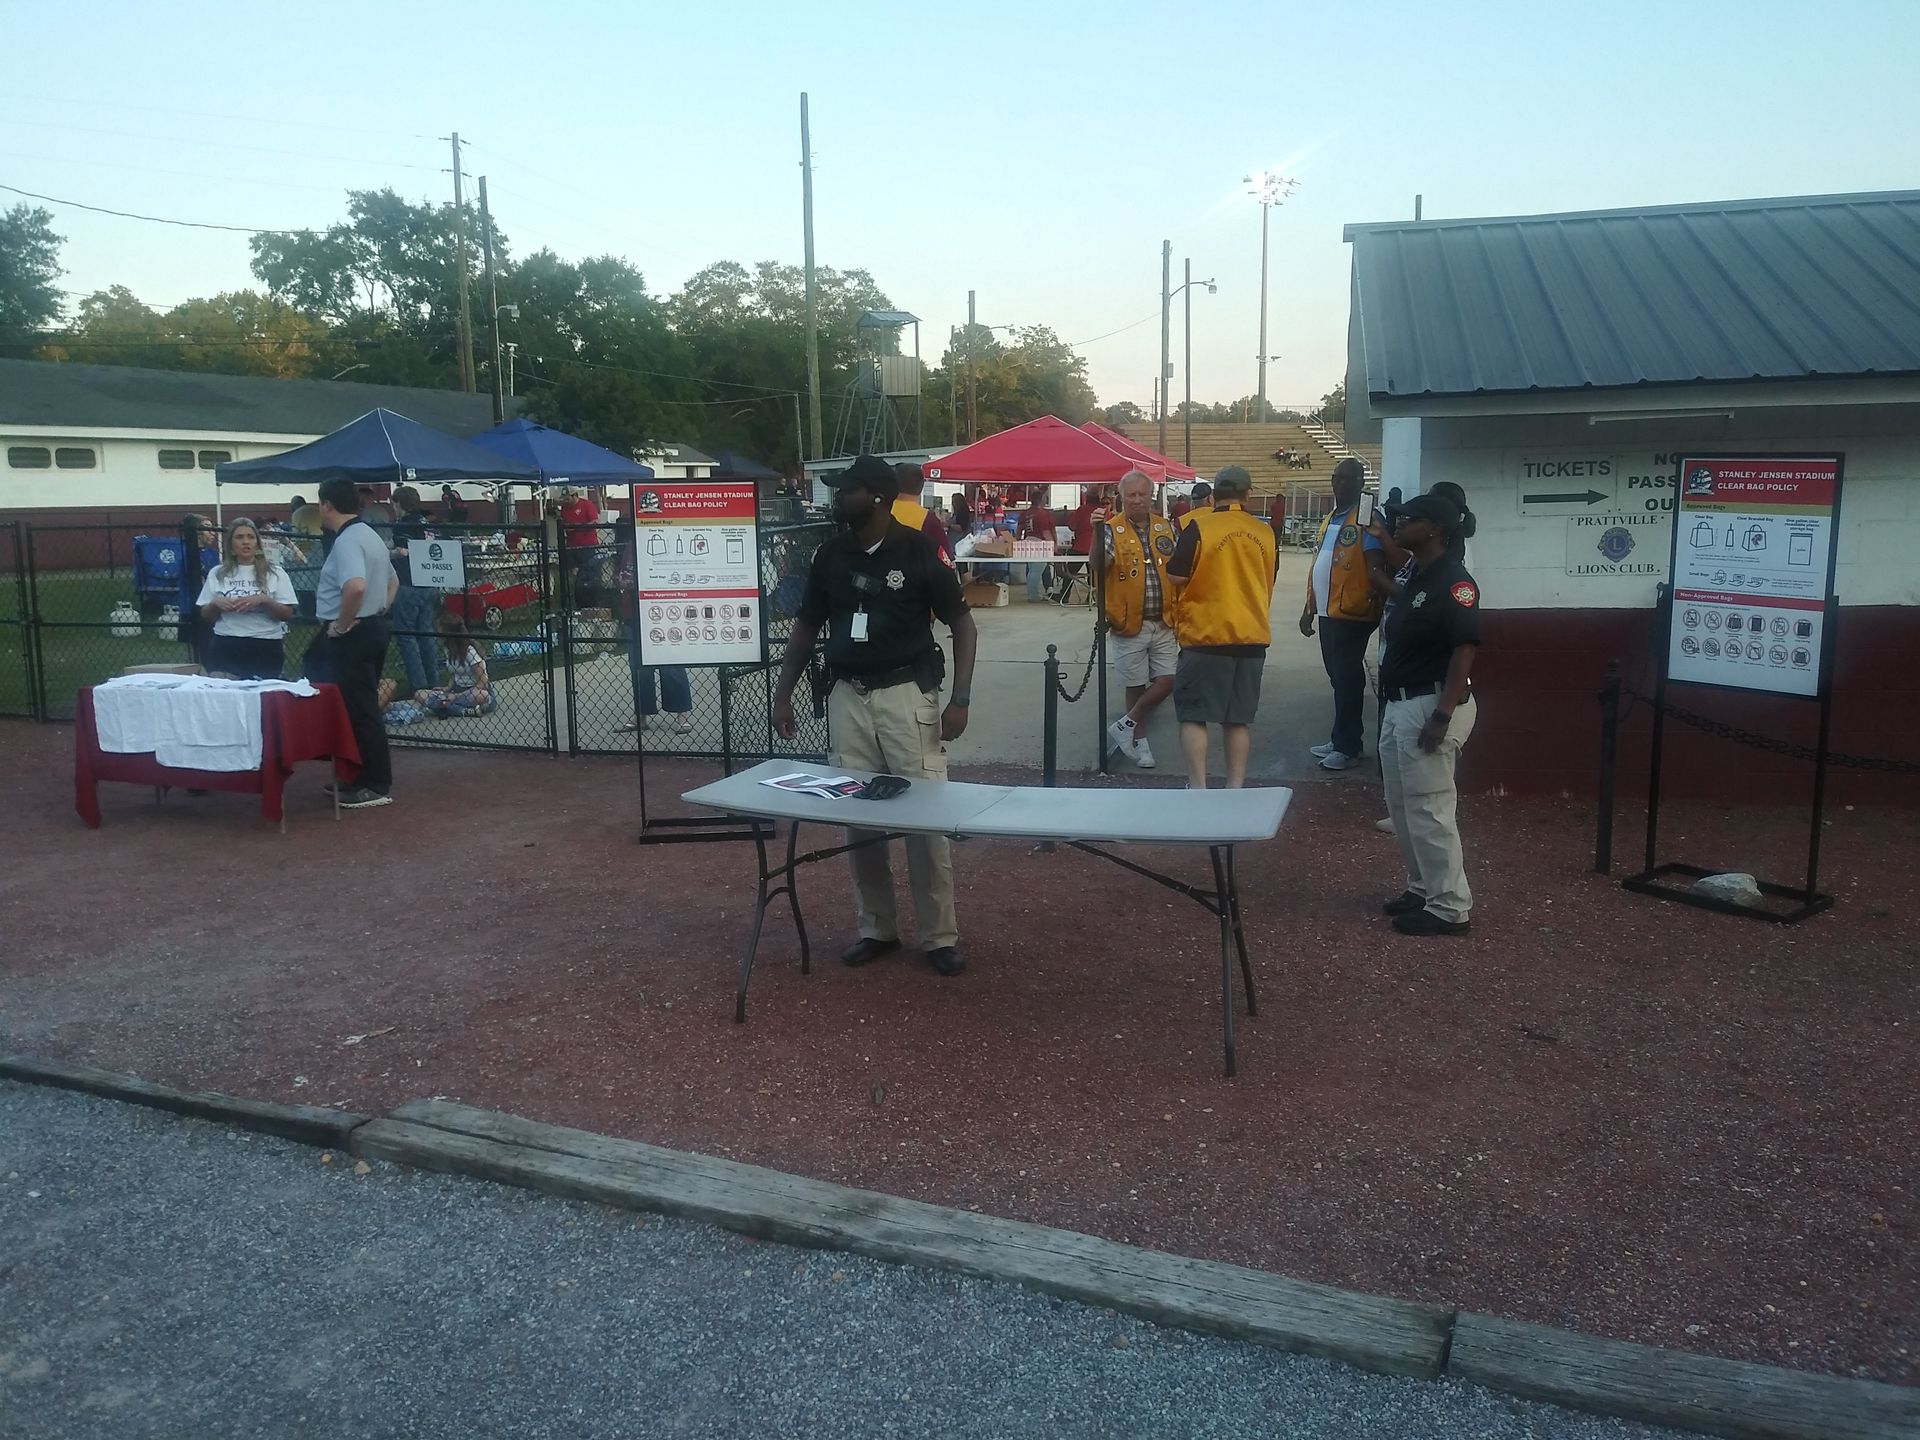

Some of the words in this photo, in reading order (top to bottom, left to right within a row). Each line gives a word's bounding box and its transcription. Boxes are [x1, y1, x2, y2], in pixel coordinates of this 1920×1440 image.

[1524, 460, 1611, 478] TICKETS
[1718, 471, 1757, 479] STANLEY
[1758, 471, 1793, 480] JENSEN
[1795, 472, 1835, 481] STADIUM
[1628, 475, 1677, 488] PASS
[1747, 483, 1765, 491] BAG
[1766, 484, 1799, 492] POLICY
[1645, 498, 1674, 511] OU
[1577, 515, 1658, 526] PRATTVILLE
[432, 563, 453, 571] PASSES
[1577, 565, 1616, 574] LIONS
[1619, 564, 1655, 573] CLUB
[229, 579, 245, 587] VOTE
